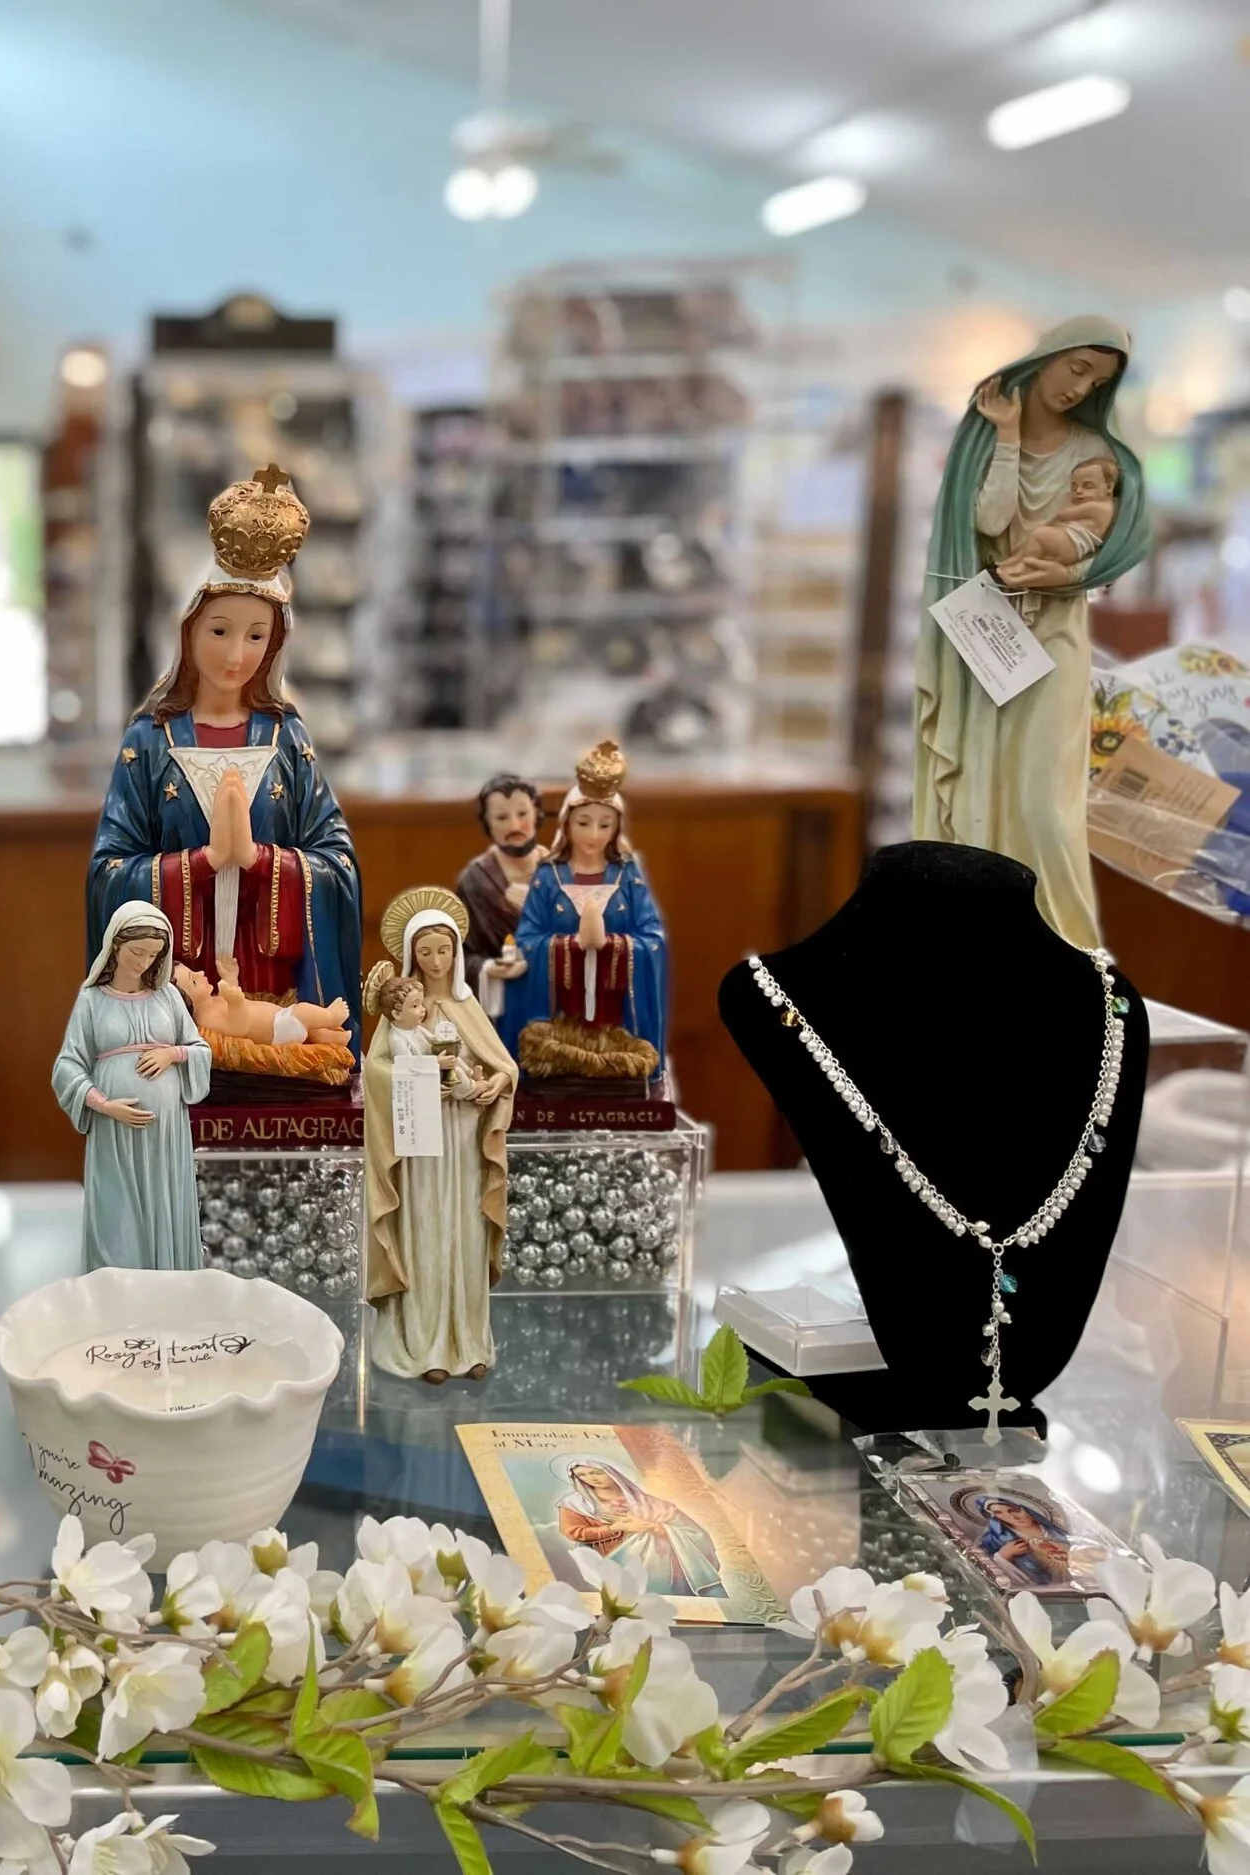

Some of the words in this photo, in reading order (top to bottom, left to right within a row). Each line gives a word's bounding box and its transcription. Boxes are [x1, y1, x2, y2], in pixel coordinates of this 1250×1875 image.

[537, 1111, 555, 1122] DE
[569, 1111, 663, 1123] ALTAGRACIA
[199, 1118, 234, 1141] DE
[240, 1117, 364, 1140] ALTAGRAC
[86, 1345, 141, 1369] Rosy
[492, 1429, 577, 1440] Immaculate
[494, 1439, 507, 1448] of
[514, 1439, 559, 1449] Mary
[38, 1443, 81, 1469] you're
